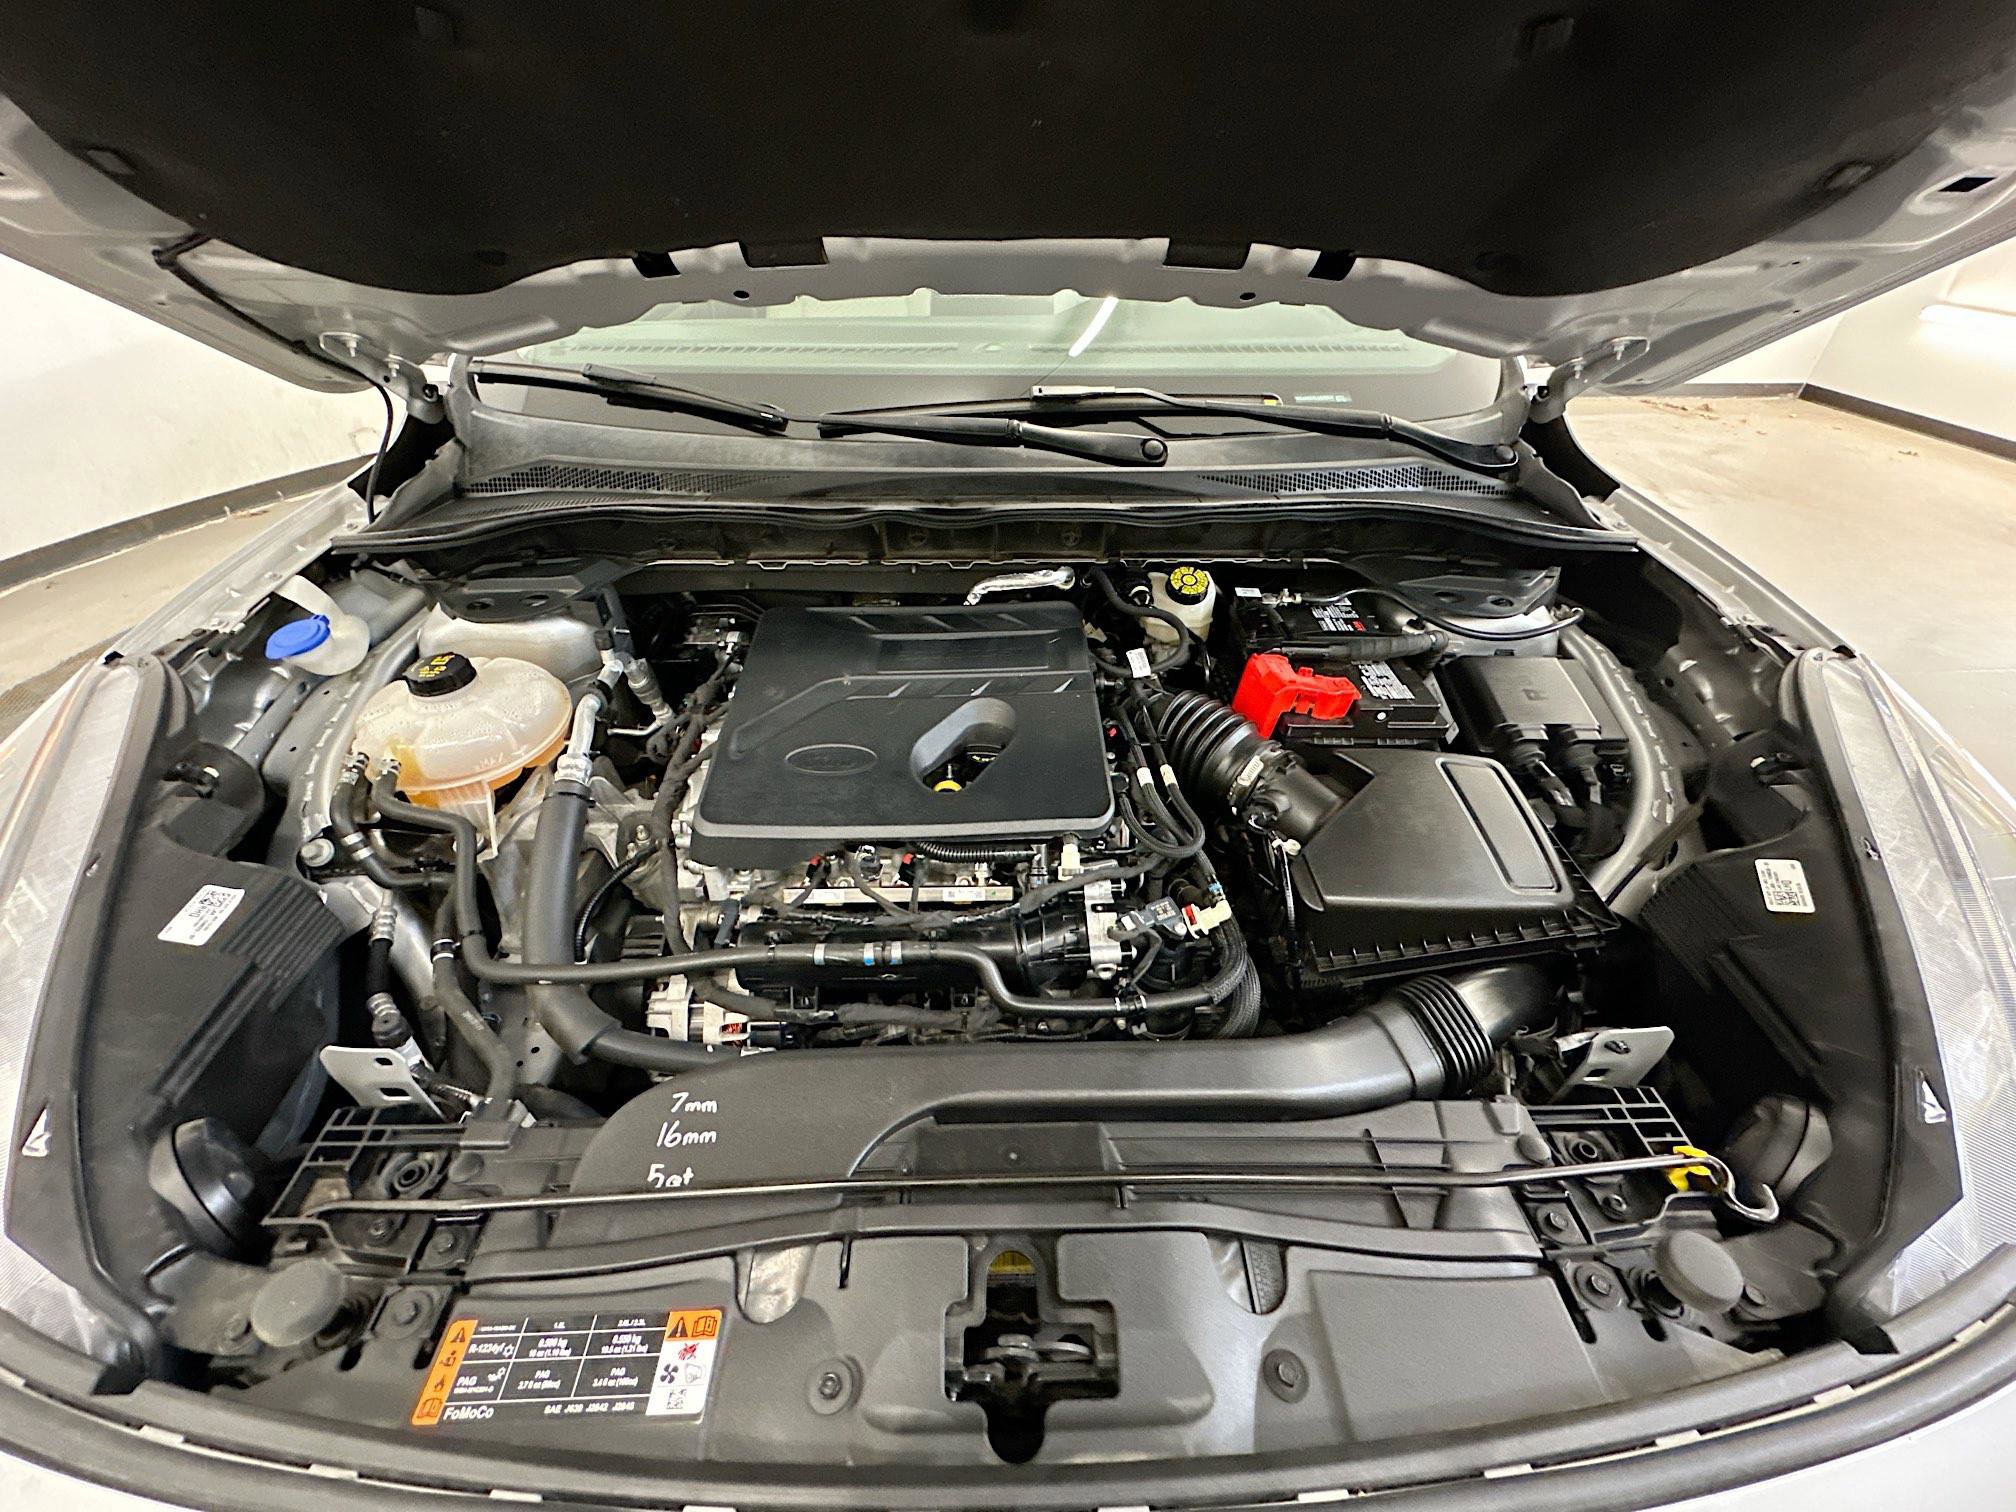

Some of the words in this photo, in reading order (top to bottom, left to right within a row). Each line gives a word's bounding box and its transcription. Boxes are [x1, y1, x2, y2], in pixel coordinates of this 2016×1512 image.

[671, 1091, 718, 1114] 7mm
[656, 1119, 717, 1148] 16mm
[468, 1342, 506, 1356] R-1234yf
[534, 1369, 551, 1379] PAG
[610, 1367, 626, 1376] PAG
[456, 1376, 478, 1387] PAG
[443, 1405, 495, 1420] FoMoCo
[544, 1405, 562, 1414] SAE
